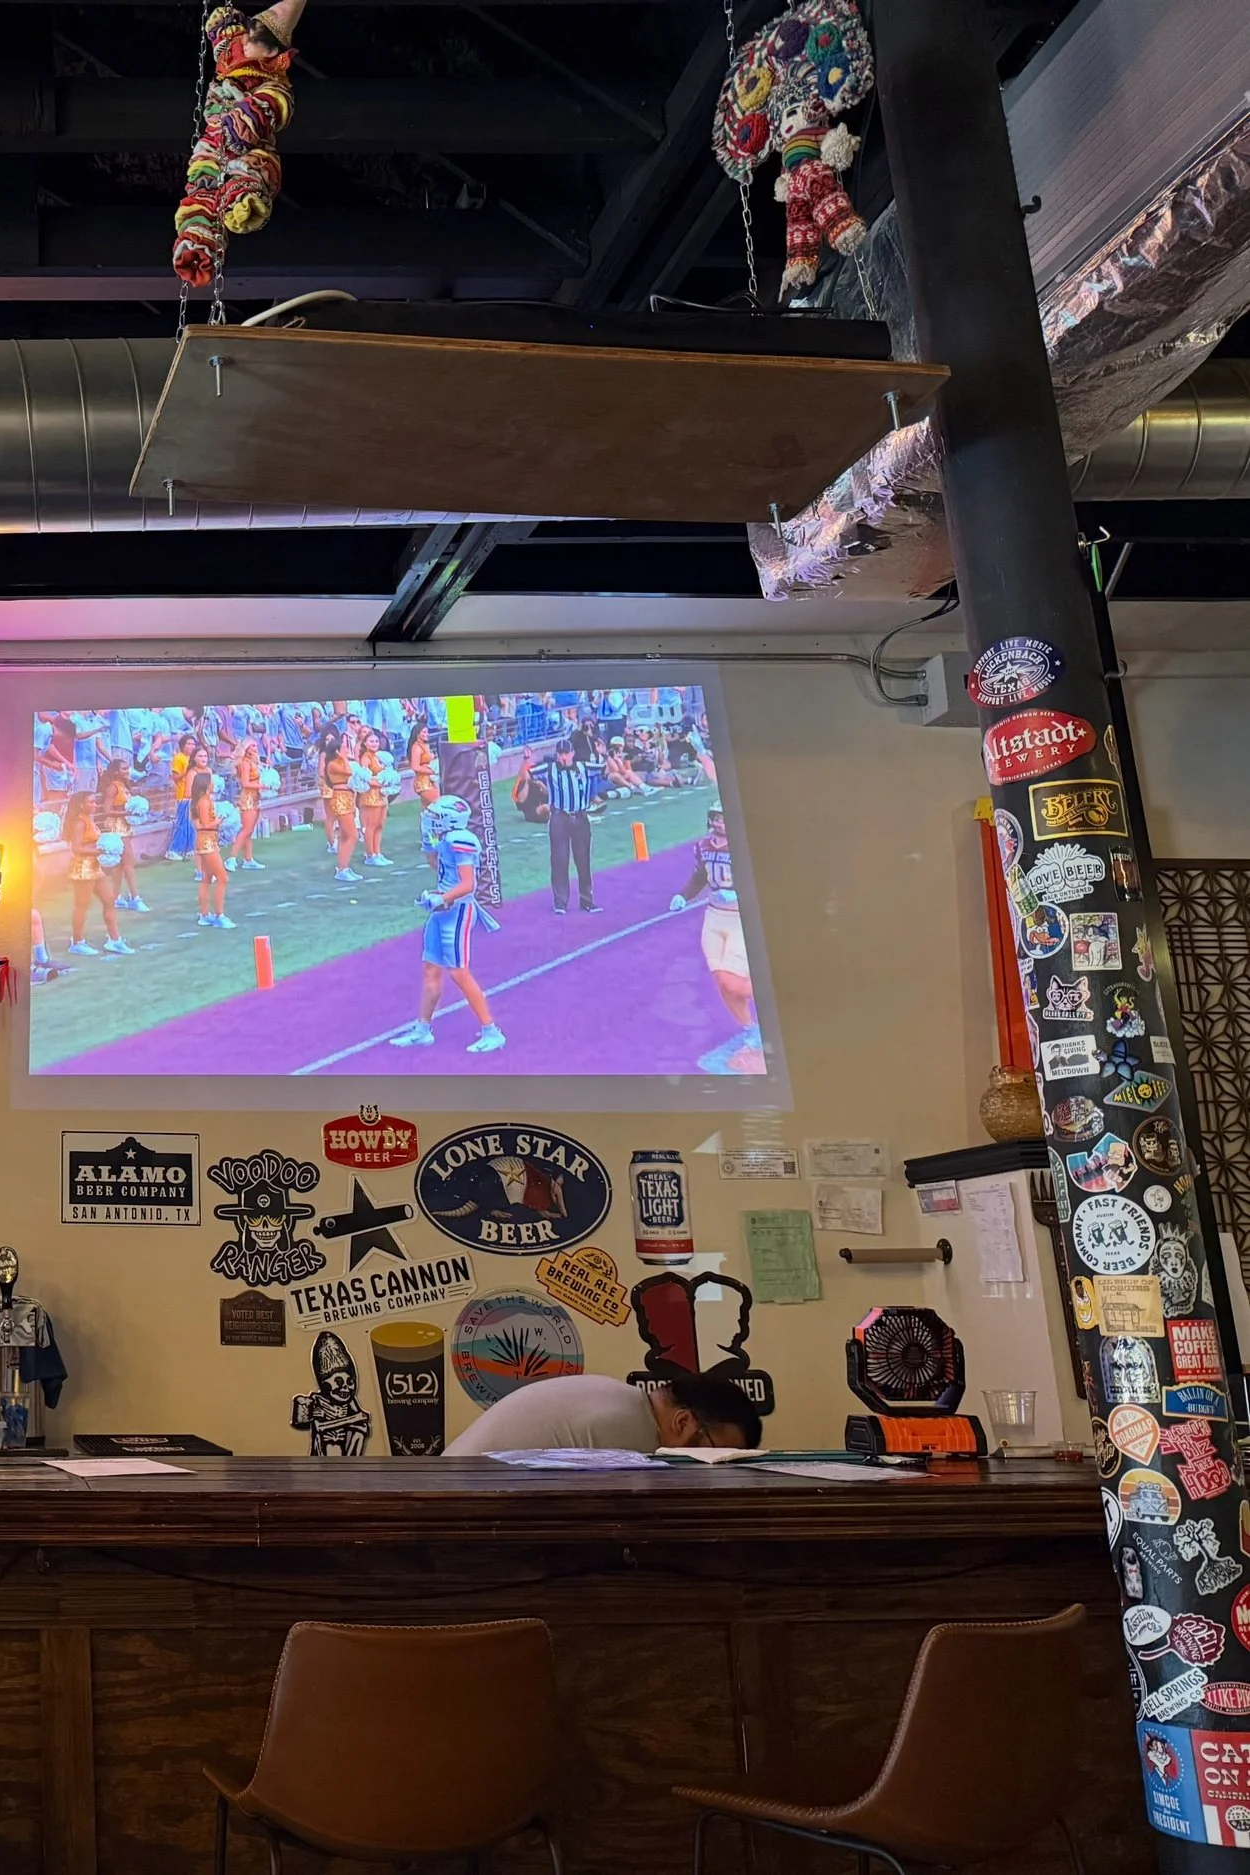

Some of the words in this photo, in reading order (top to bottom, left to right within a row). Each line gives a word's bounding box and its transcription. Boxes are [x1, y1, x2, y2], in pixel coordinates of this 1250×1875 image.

[973, 647, 996, 674] SUPPORT
[999, 639, 1019, 650] LIVE
[1025, 639, 1053, 654] MUSIC
[982, 649, 1044, 679] LUCKENBACH
[977, 692, 1005, 706] SUPPORT
[1009, 690, 1028, 703] LIVE
[1030, 673, 1056, 694] MUSIC
[993, 677, 1031, 694] TEXAS
[1012, 711, 1038, 721] GERMAN
[478, 771, 500, 904] BOBCATS
[1030, 869, 1059, 887] LOVE
[1066, 863, 1102, 876] BEER
[1059, 887, 1092, 898] UNTURNED
[1061, 1040, 1086, 1048] THANKS
[1063, 1046, 1086, 1055] GIVING
[1051, 1066, 1090, 1077] MELTDOWN
[329, 1129, 411, 1150] HOWDY
[354, 1152, 390, 1163] BEER
[429, 1134, 504, 1182] LONE
[516, 1134, 591, 1182] STAR
[74, 1165, 186, 1184] ALAMO
[211, 1153, 317, 1191] VOODOO
[76, 1185, 114, 1196] BEER
[121, 1186, 186, 1198] COMPANY
[639, 1179, 679, 1198] TEXAS
[72, 1206, 97, 1219] SAN
[176, 1208, 190, 1221] TX
[642, 1199, 680, 1218] LIGHT
[478, 1219, 561, 1244] BEER
[1087, 1197, 1118, 1211] FAST
[1121, 1202, 1150, 1251] FRIENDS
[1075, 1214, 1099, 1267] COMPANY
[214, 1243, 324, 1282] RANGER
[1103, 1257, 1136, 1271] BEER
[291, 1277, 367, 1315] TEXAS
[370, 1256, 471, 1299] CANNON
[547, 1266, 601, 1303] BREWING
[562, 1259, 590, 1284] REAL
[594, 1279, 618, 1298] ALE
[232, 1309, 254, 1319] VOTED
[256, 1310, 274, 1320] BEST
[323, 1301, 381, 1323] BREWING
[387, 1287, 446, 1310] COMPANY
[464, 1302, 492, 1335] SAVE
[495, 1295, 526, 1305] THE
[531, 1299, 572, 1345] WORLD
[1171, 1326, 1216, 1341] MAKE
[1174, 1340, 1218, 1355] COFFEE
[1176, 1354, 1201, 1369] GREAT
[385, 1370, 439, 1398] (512)
[1132, 1531, 1157, 1559] EQUAL
[1157, 1559, 1183, 1585] PARTS
[1175, 1624, 1201, 1660] BREWING
[1182, 1619, 1218, 1659] ODELL
[1143, 1695, 1164, 1715] BELL
[1160, 1670, 1205, 1702] SPRINGS
[1213, 1688, 1236, 1708] LIKE
[1157, 1697, 1188, 1720] BREWING
[1204, 1767, 1240, 1787] ON
[1153, 1790, 1181, 1811] SIMCOE
[1153, 1810, 1190, 1835] PRESIDENT
